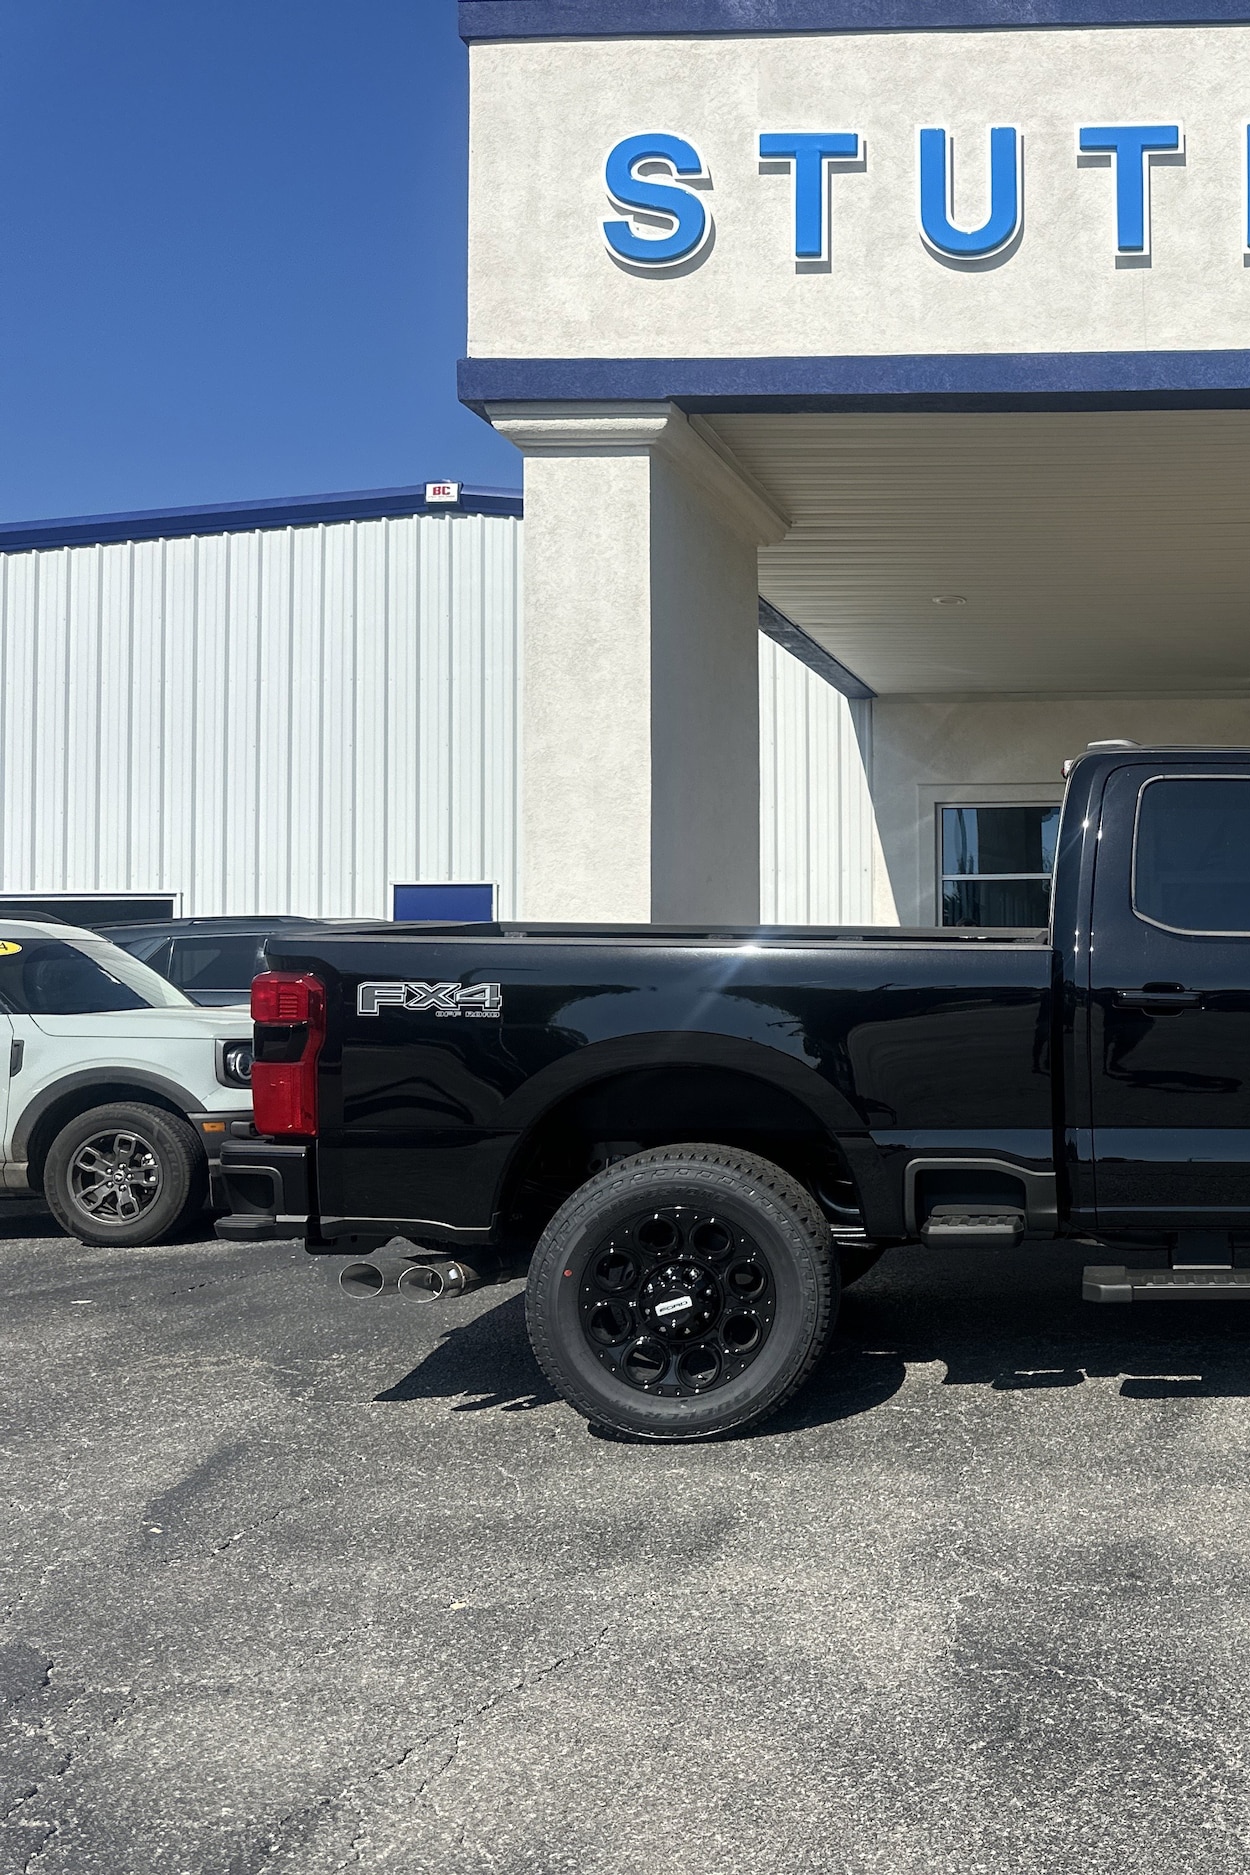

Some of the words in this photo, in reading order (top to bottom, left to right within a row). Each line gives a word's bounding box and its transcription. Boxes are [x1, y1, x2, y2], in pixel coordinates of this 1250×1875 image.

[433, 486, 450, 495] BC
[357, 981, 503, 1017] FX4
[435, 1010, 462, 1018] OFF
[465, 1010, 501, 1019] ROAD
